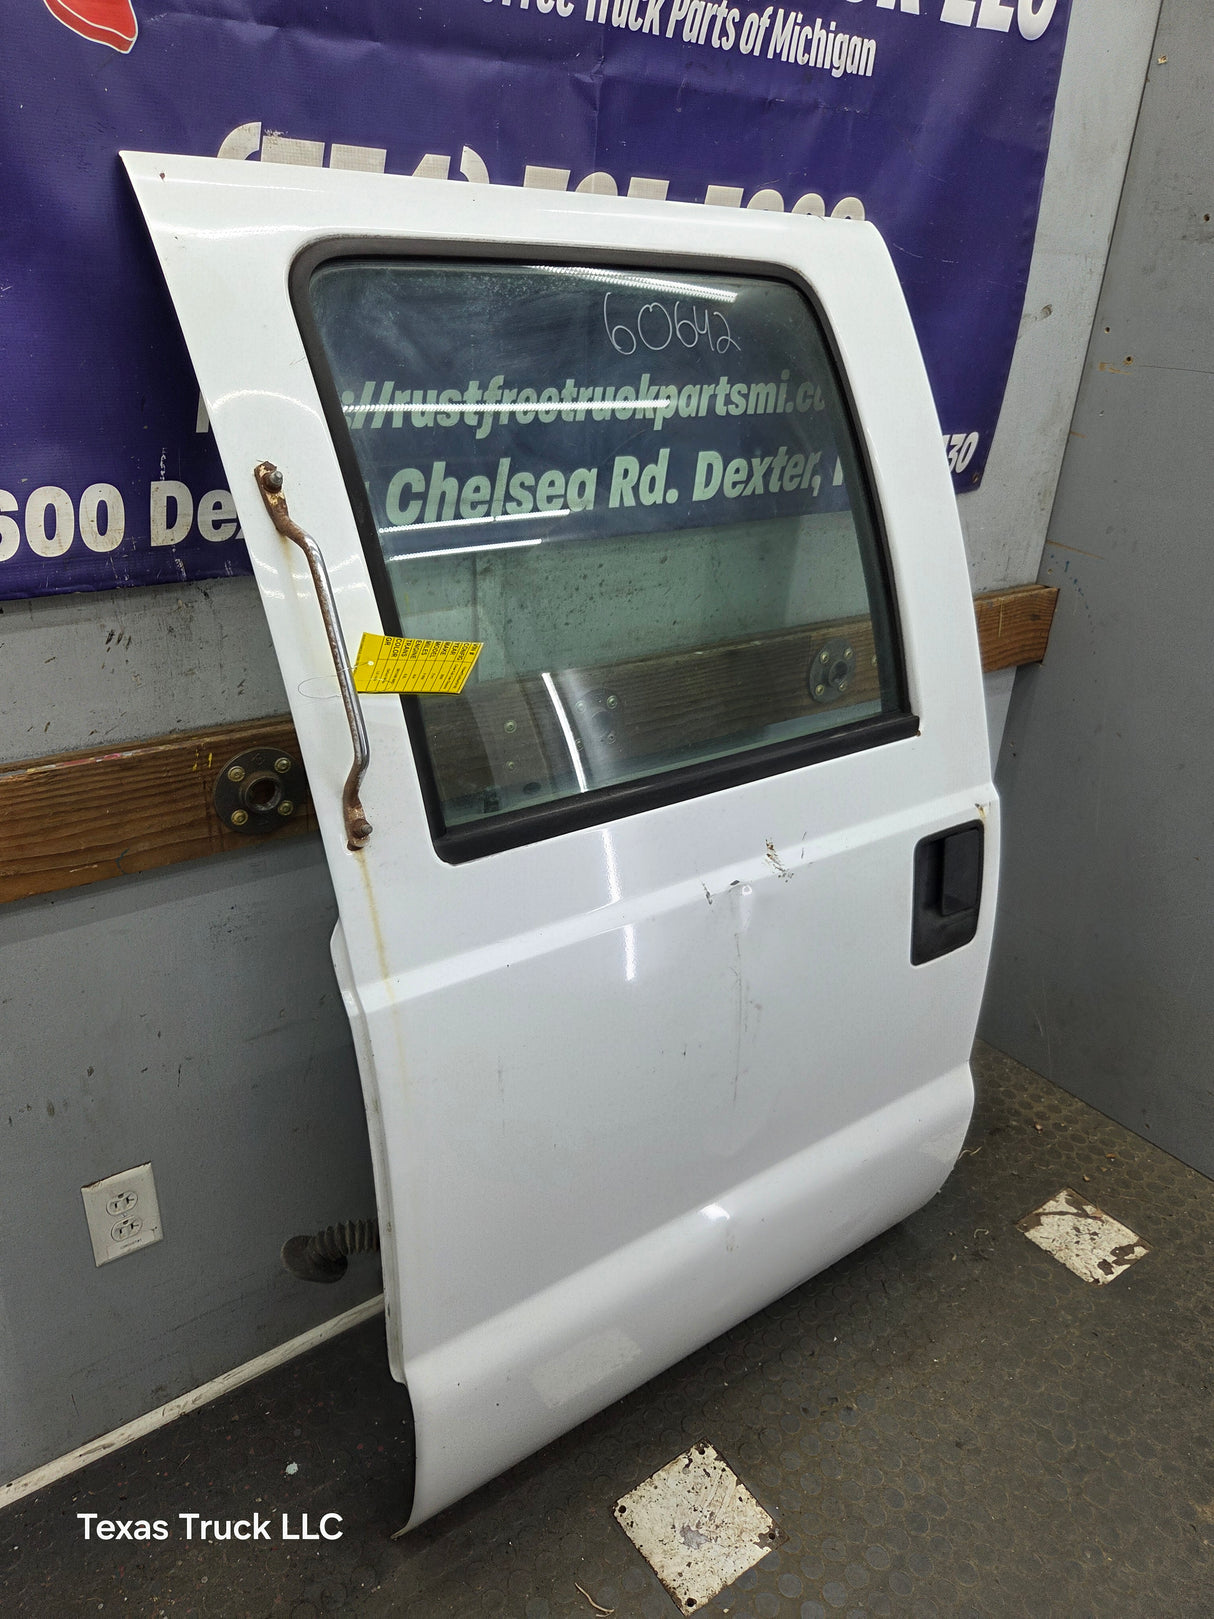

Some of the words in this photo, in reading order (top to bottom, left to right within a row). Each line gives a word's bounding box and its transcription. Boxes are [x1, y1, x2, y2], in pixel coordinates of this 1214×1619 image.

[666, 0, 742, 51] Parts
[740, 7, 774, 57] of
[767, 9, 877, 78] Michigan
[604, 292, 742, 355] 60642
[385, 457, 598, 527] Chelsea
[608, 448, 679, 509] Rd.
[692, 446, 822, 502] Dexter,
[150, 480, 244, 547] De
[391, 638, 403, 658] COLOR
[401, 639, 412, 658] TRANS
[410, 639, 422, 659] ENGINE
[429, 641, 441, 658] MODEL
